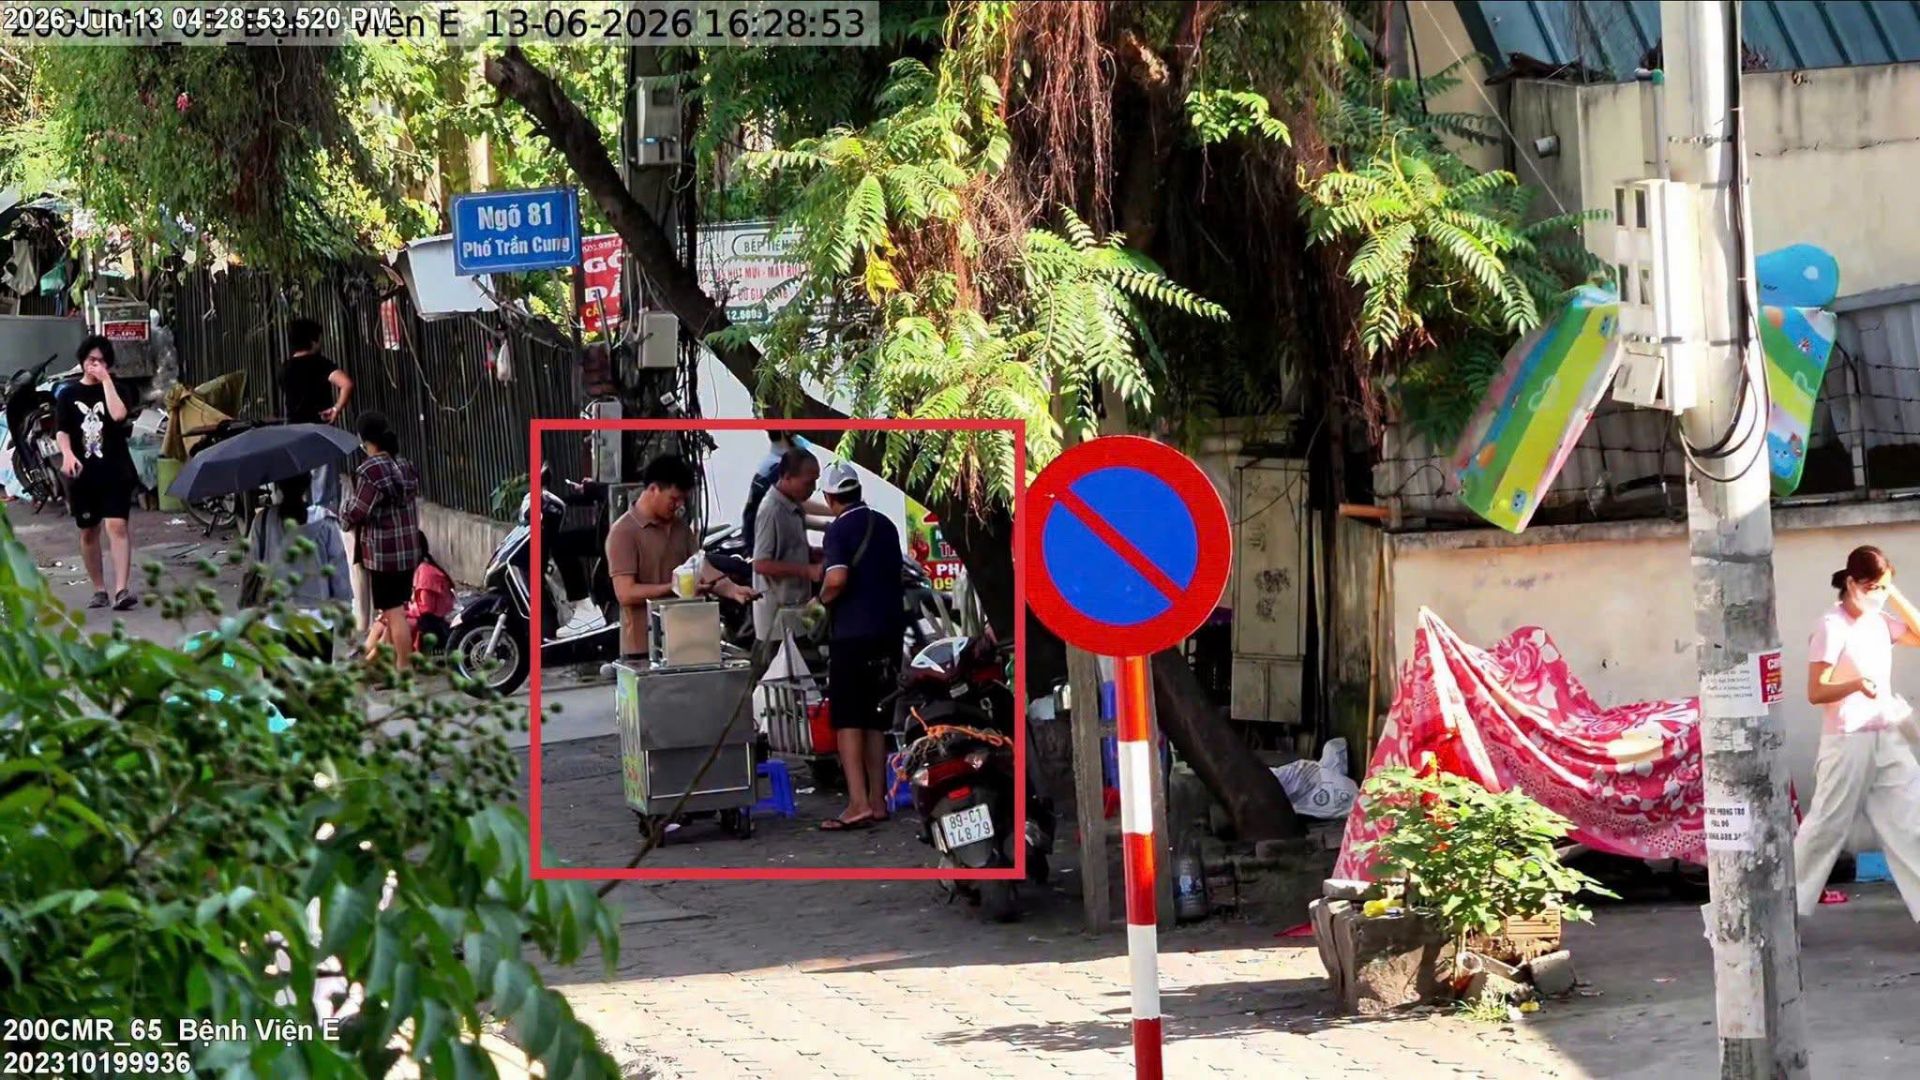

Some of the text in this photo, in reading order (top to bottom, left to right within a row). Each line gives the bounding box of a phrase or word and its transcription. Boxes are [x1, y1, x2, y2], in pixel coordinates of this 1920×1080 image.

[477, 201, 553, 232] Ngõ 81
[462, 237, 493, 258] Phố
[495, 235, 530, 256] Trần
[949, 808, 983, 829] 89-C1
[949, 821, 991, 845] 148.79
